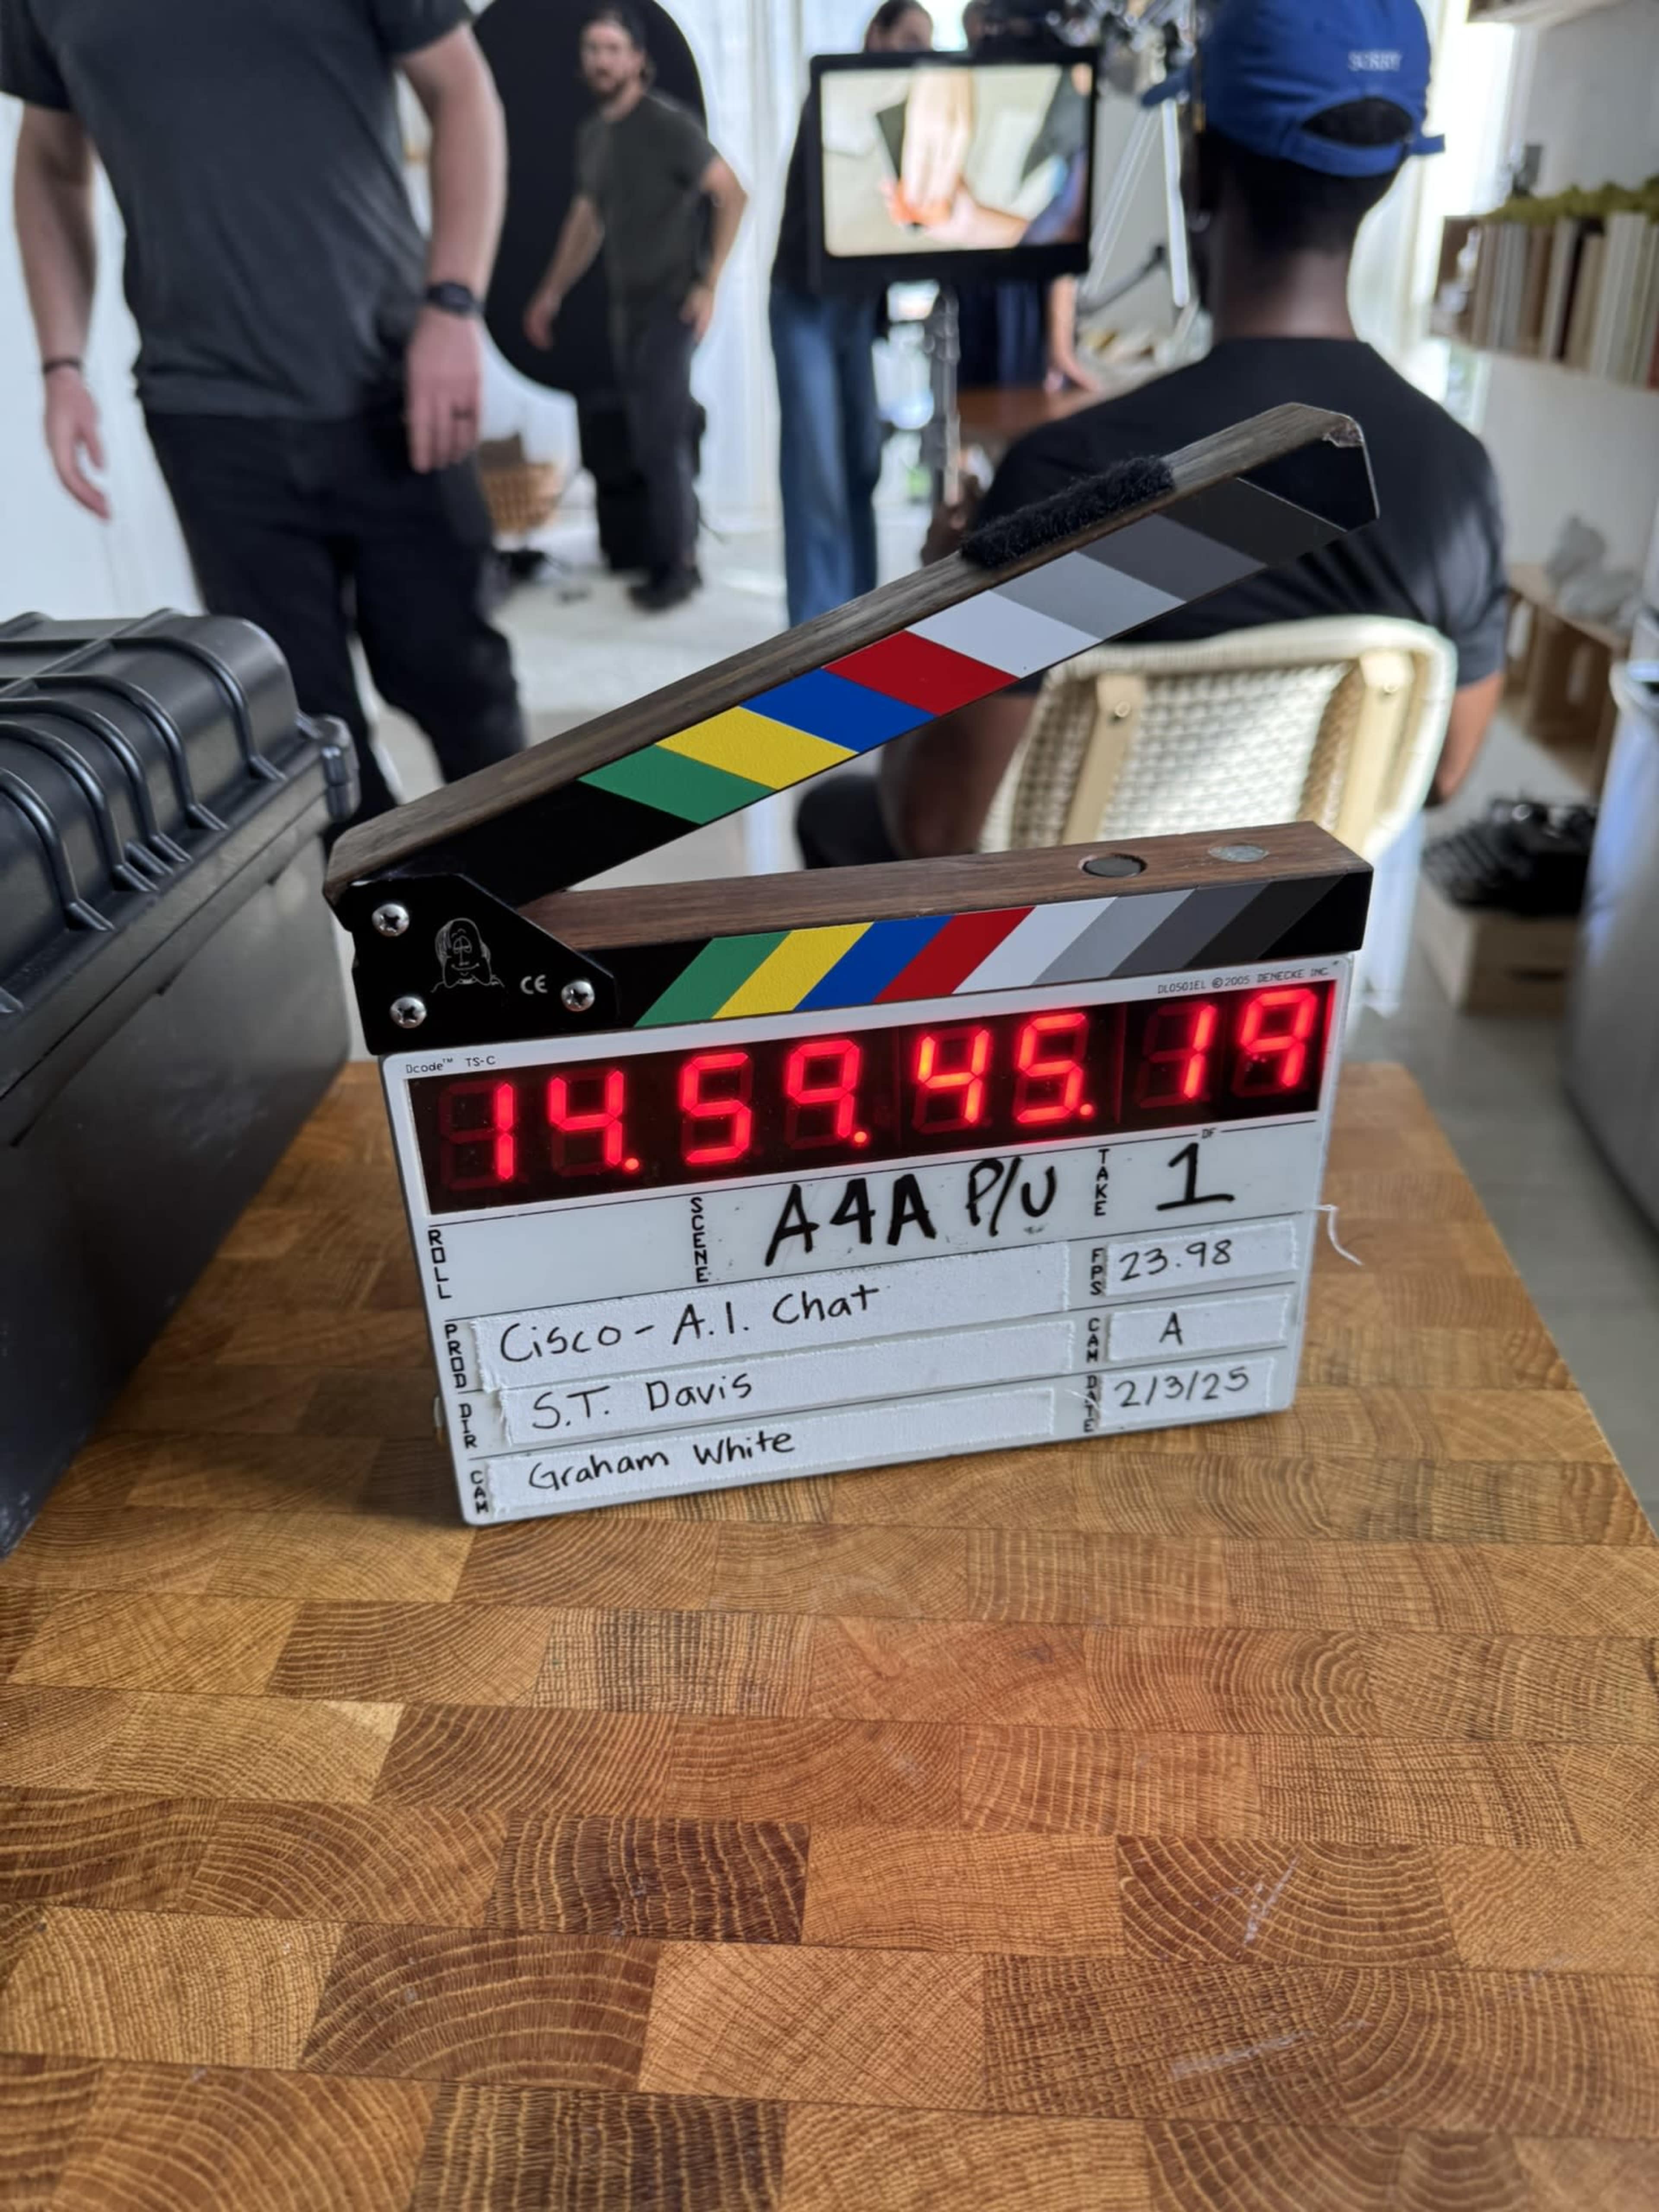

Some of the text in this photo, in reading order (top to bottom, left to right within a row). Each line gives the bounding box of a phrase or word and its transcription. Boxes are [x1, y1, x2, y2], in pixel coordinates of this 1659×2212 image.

[520, 975, 547, 994] CE
[1257, 969, 1305, 983] DENECKE
[464, 1055, 496, 1068] TS-C
[1094, 1148, 1110, 1217] TAKE
[1157, 1142, 1235, 1211] 1
[765, 1156, 1057, 1266] A4A P/U
[690, 1196, 709, 1283] SCENE
[1119, 1239, 1233, 1282] 23.98
[428, 1230, 451, 1299] ROLL
[1090, 1247, 1104, 1296] FPS
[772, 1284, 880, 1324] Chat
[1086, 1318, 1100, 1363] CAM
[1159, 1312, 1184, 1345] A
[445, 1323, 467, 1388] PROD
[532, 1373, 753, 1429] S.T. Davis
[1084, 1375, 1098, 1433] DATE
[1114, 1366, 1250, 1408] 2/3/25
[458, 1403, 477, 1448] DIR
[528, 1430, 795, 1491] Graham White
[470, 1470, 489, 1514] CAM
